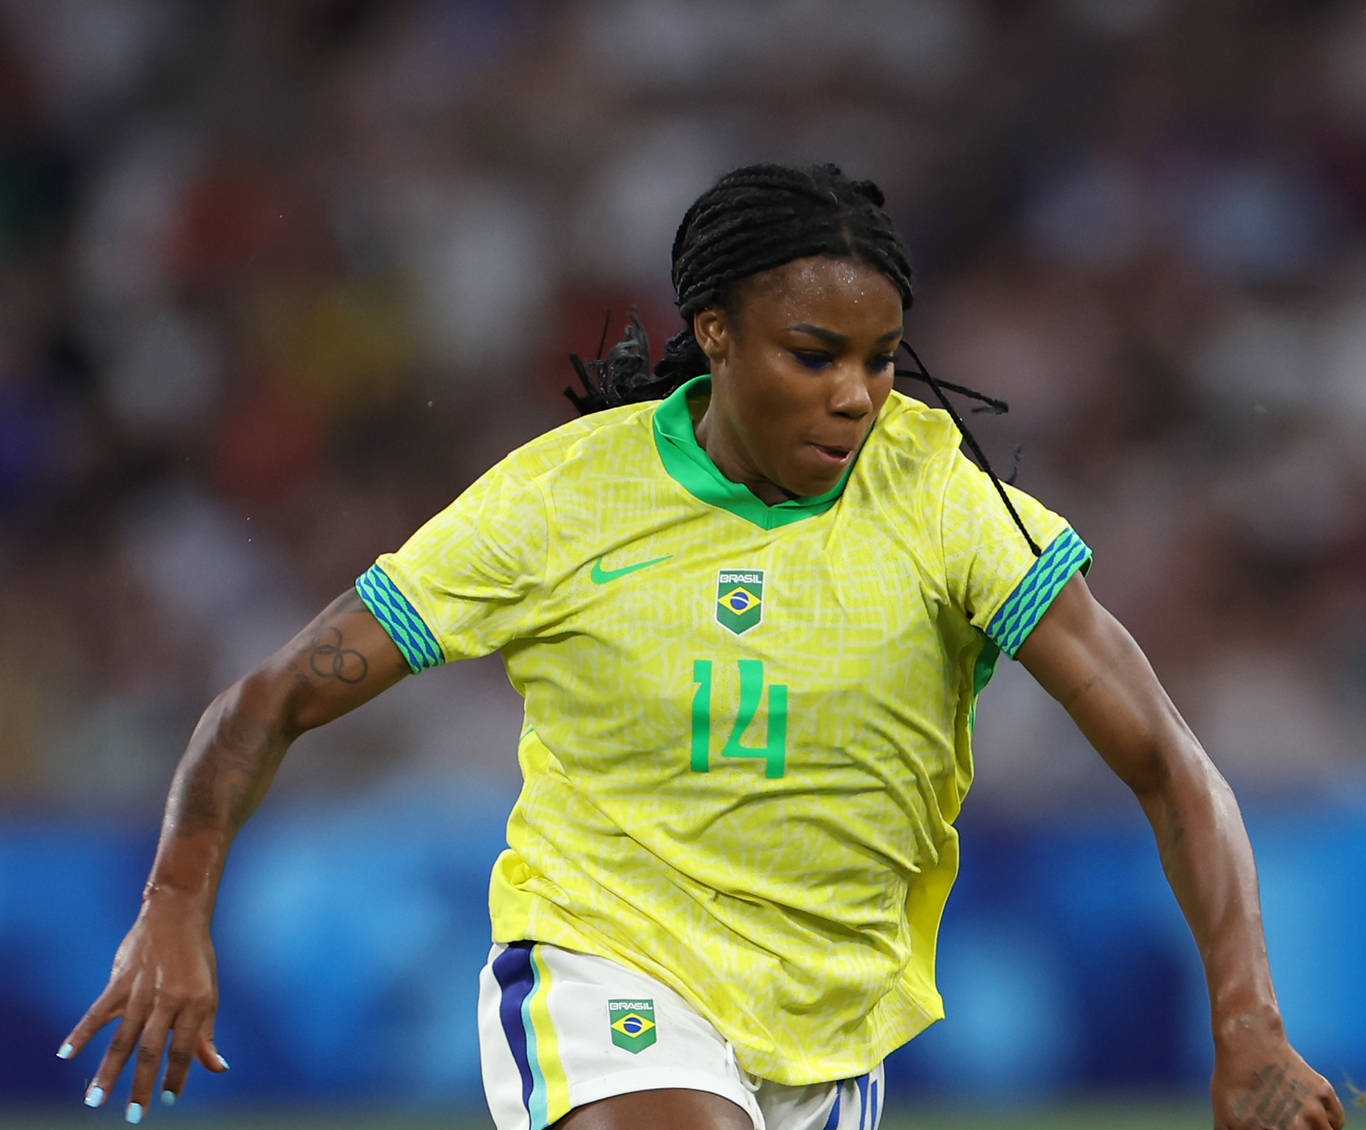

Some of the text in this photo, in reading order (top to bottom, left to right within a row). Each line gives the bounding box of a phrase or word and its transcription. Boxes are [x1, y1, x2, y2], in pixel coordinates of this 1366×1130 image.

[719, 573, 763, 584] BRASIL
[690, 659, 788, 779] 14
[609, 1002, 653, 1011] BRASIL
